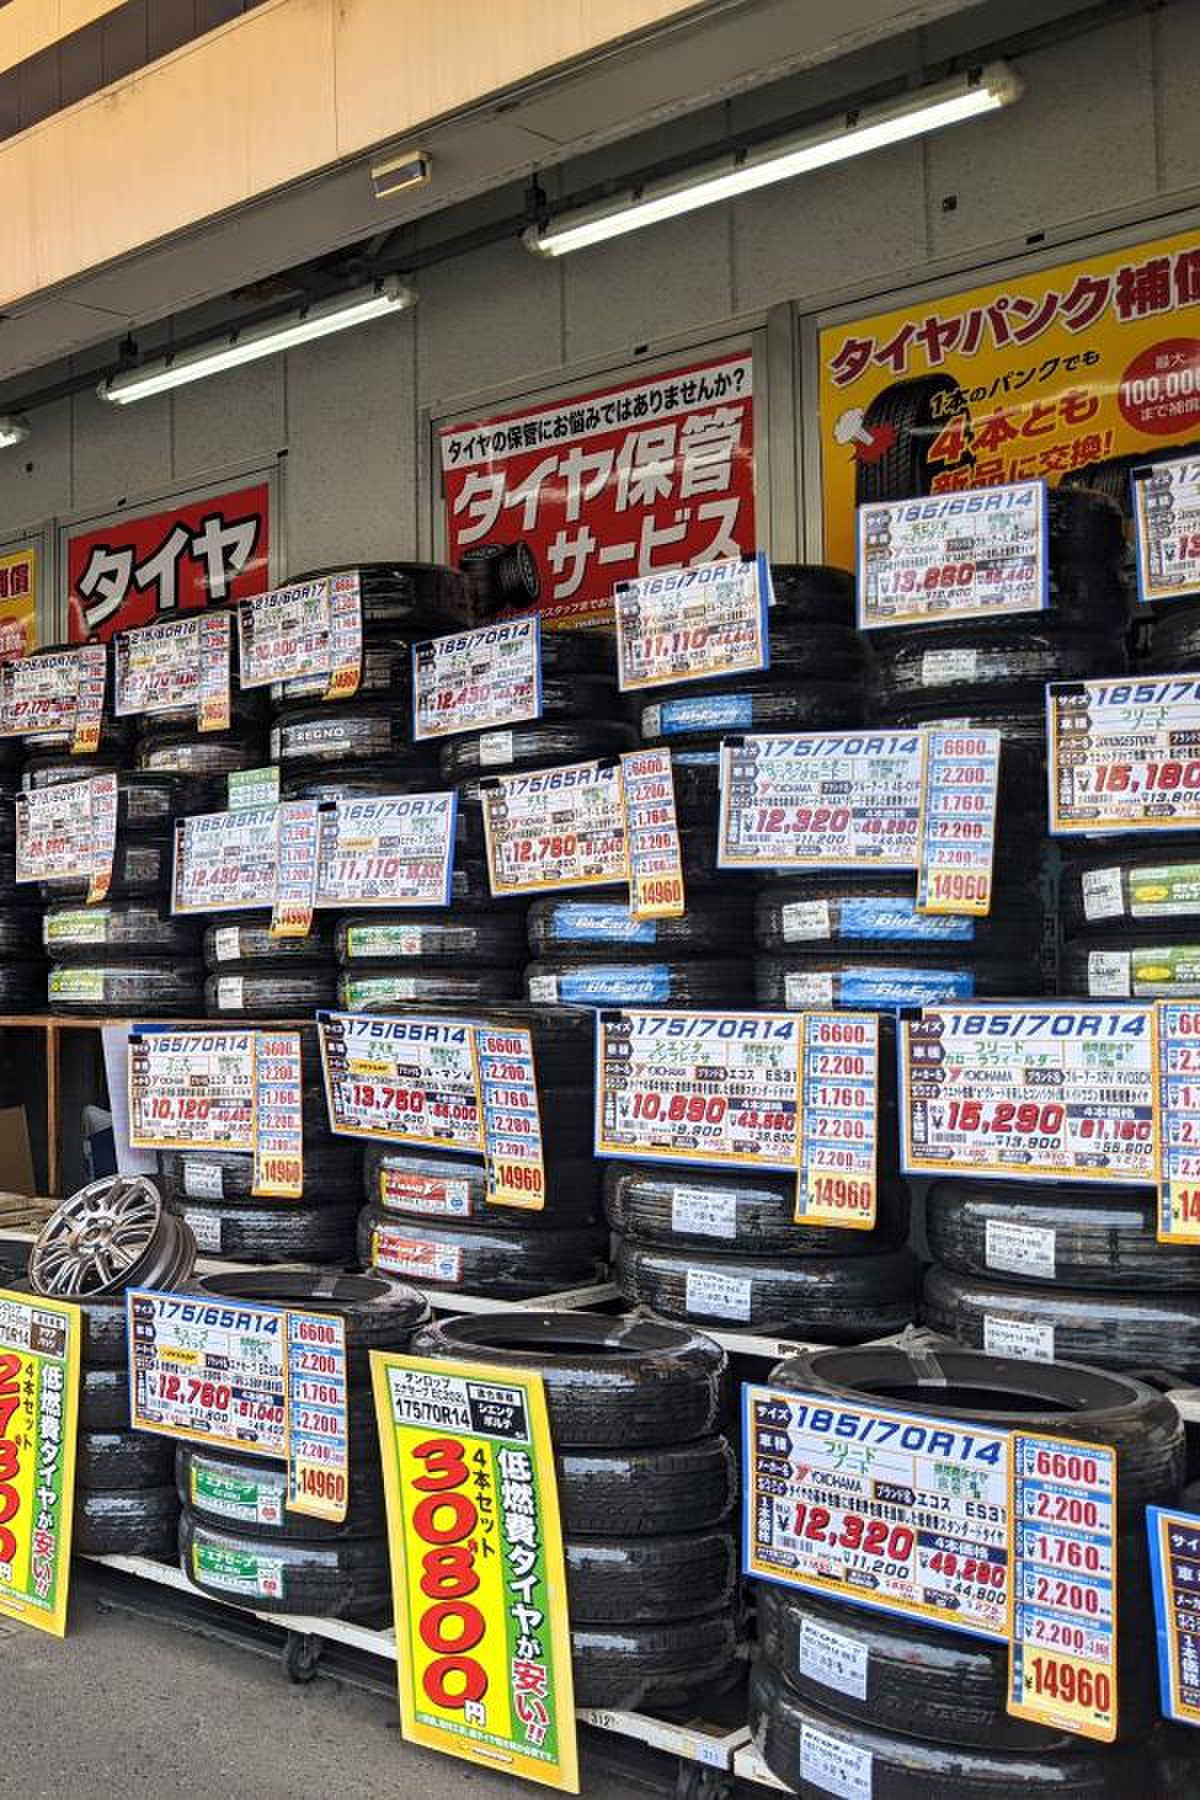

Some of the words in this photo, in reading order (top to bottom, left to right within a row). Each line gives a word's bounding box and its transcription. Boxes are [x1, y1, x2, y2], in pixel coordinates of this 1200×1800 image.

[931, 350, 1100, 418] 1本のパンクでも
[448, 367, 745, 462] タイヤの保管にお悩みではありませんか?
[928, 389, 1100, 464] 4本とも
[453, 405, 744, 545] タイヤ保管
[930, 430, 1116, 495] 新品に交換!
[897, 490, 1034, 523] 185/65R14
[547, 498, 742, 600] サービス
[79, 515, 258, 627] タイヤ
[763, 737, 918, 757] 175/70R14
[506, 767, 615, 798] 175/65R14
[337, 800, 447, 820] 165/70R14
[349, 1022, 466, 1044] 175/65R14
[637, 1018, 794, 1040] 175/70R14
[910, 1021, 941, 1033] サイズ
[950, 1015, 1146, 1037] 185/70R14
[152, 1037, 248, 1053] 165/70R14
[975, 1041, 1024, 1051] フリード
[963, 1070, 1013, 1082] YOKOHAMA
[499, 1164, 542, 1192] 14960
[158, 1300, 279, 1335] 175/65R14
[404, 1372, 450, 1389] ダンロップ
[22, 1361, 35, 1451] 4本セット
[395, 1398, 470, 1428] 175/70R14
[478, 1403, 515, 1418] シエンタ
[757, 1407, 791, 1422] サイズ
[797, 1405, 1002, 1466] 185/70R14
[823, 1439, 876, 1463] フリード
[832, 1456, 869, 1474] ノート
[299, 1468, 345, 1502] 14960
[810, 1471, 863, 1494] YOKOHAMA
[916, 1493, 950, 1512] エコス
[472, 1446, 498, 1560] 4本セット
[1172, 1534, 1200, 1551] サイ
[411, 1437, 489, 1727] 30800円
[497, 1446, 551, 1746] 低燃費タイヤが安い!!
